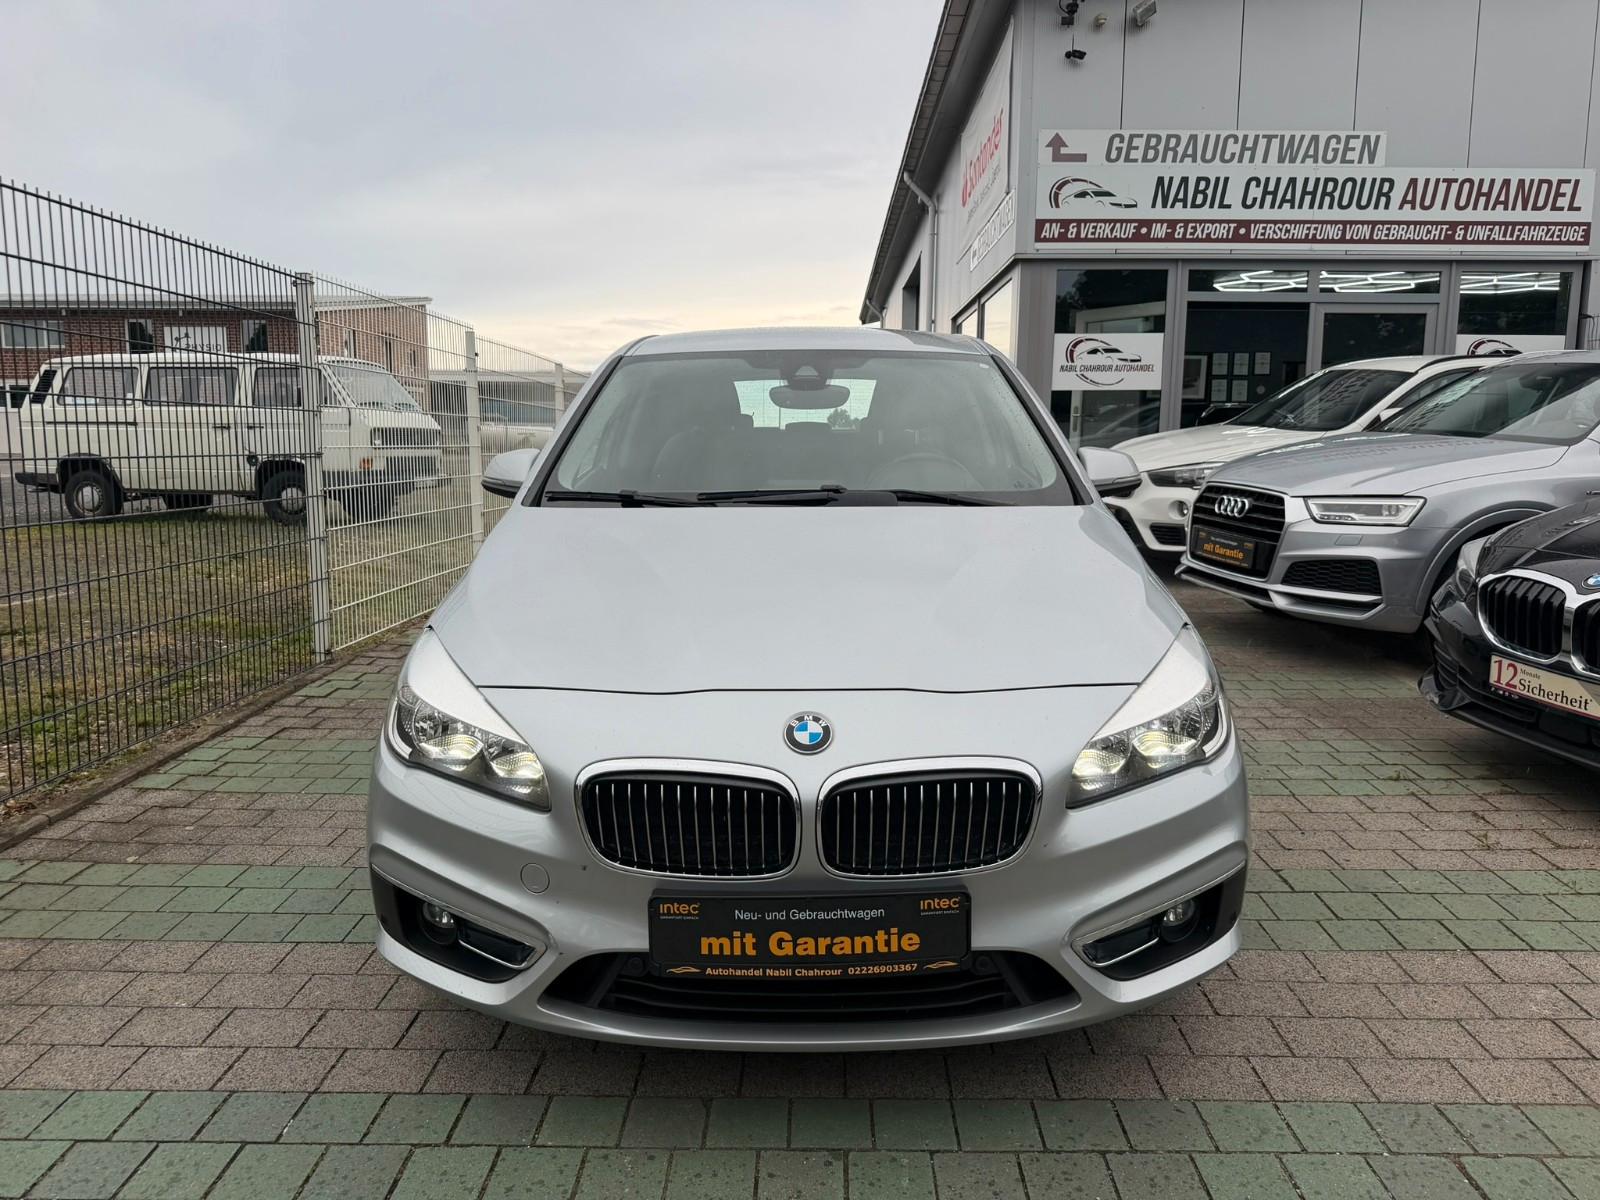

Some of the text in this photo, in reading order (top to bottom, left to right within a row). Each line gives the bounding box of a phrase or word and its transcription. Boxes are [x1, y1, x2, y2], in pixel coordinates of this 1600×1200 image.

[1104, 133, 1381, 165] GEBRAUCHTWAGEN
[1150, 176, 1582, 212] NABIL CHAHROUR AUTOHANDEL
[1041, 223, 1587, 242] AN- & VERKAUF IM- & EXPORT VERSCHIFFUNG VON GEBRAUCHT- & UNFALLFAHRZEUGE
[1059, 363, 1155, 373] NABIL CHAHROUR AUTOHANDEL
[1214, 544, 1245, 560] Garantie
[1493, 659, 1518, 690] 12
[660, 902, 699, 915] intec
[920, 897, 960, 910] intec
[734, 907, 885, 922] Neu- und Gebrauchtwagen
[700, 927, 921, 957] mit Garantie
[705, 963, 918, 977] Autohandel Nabil Chahrour 02226903367
